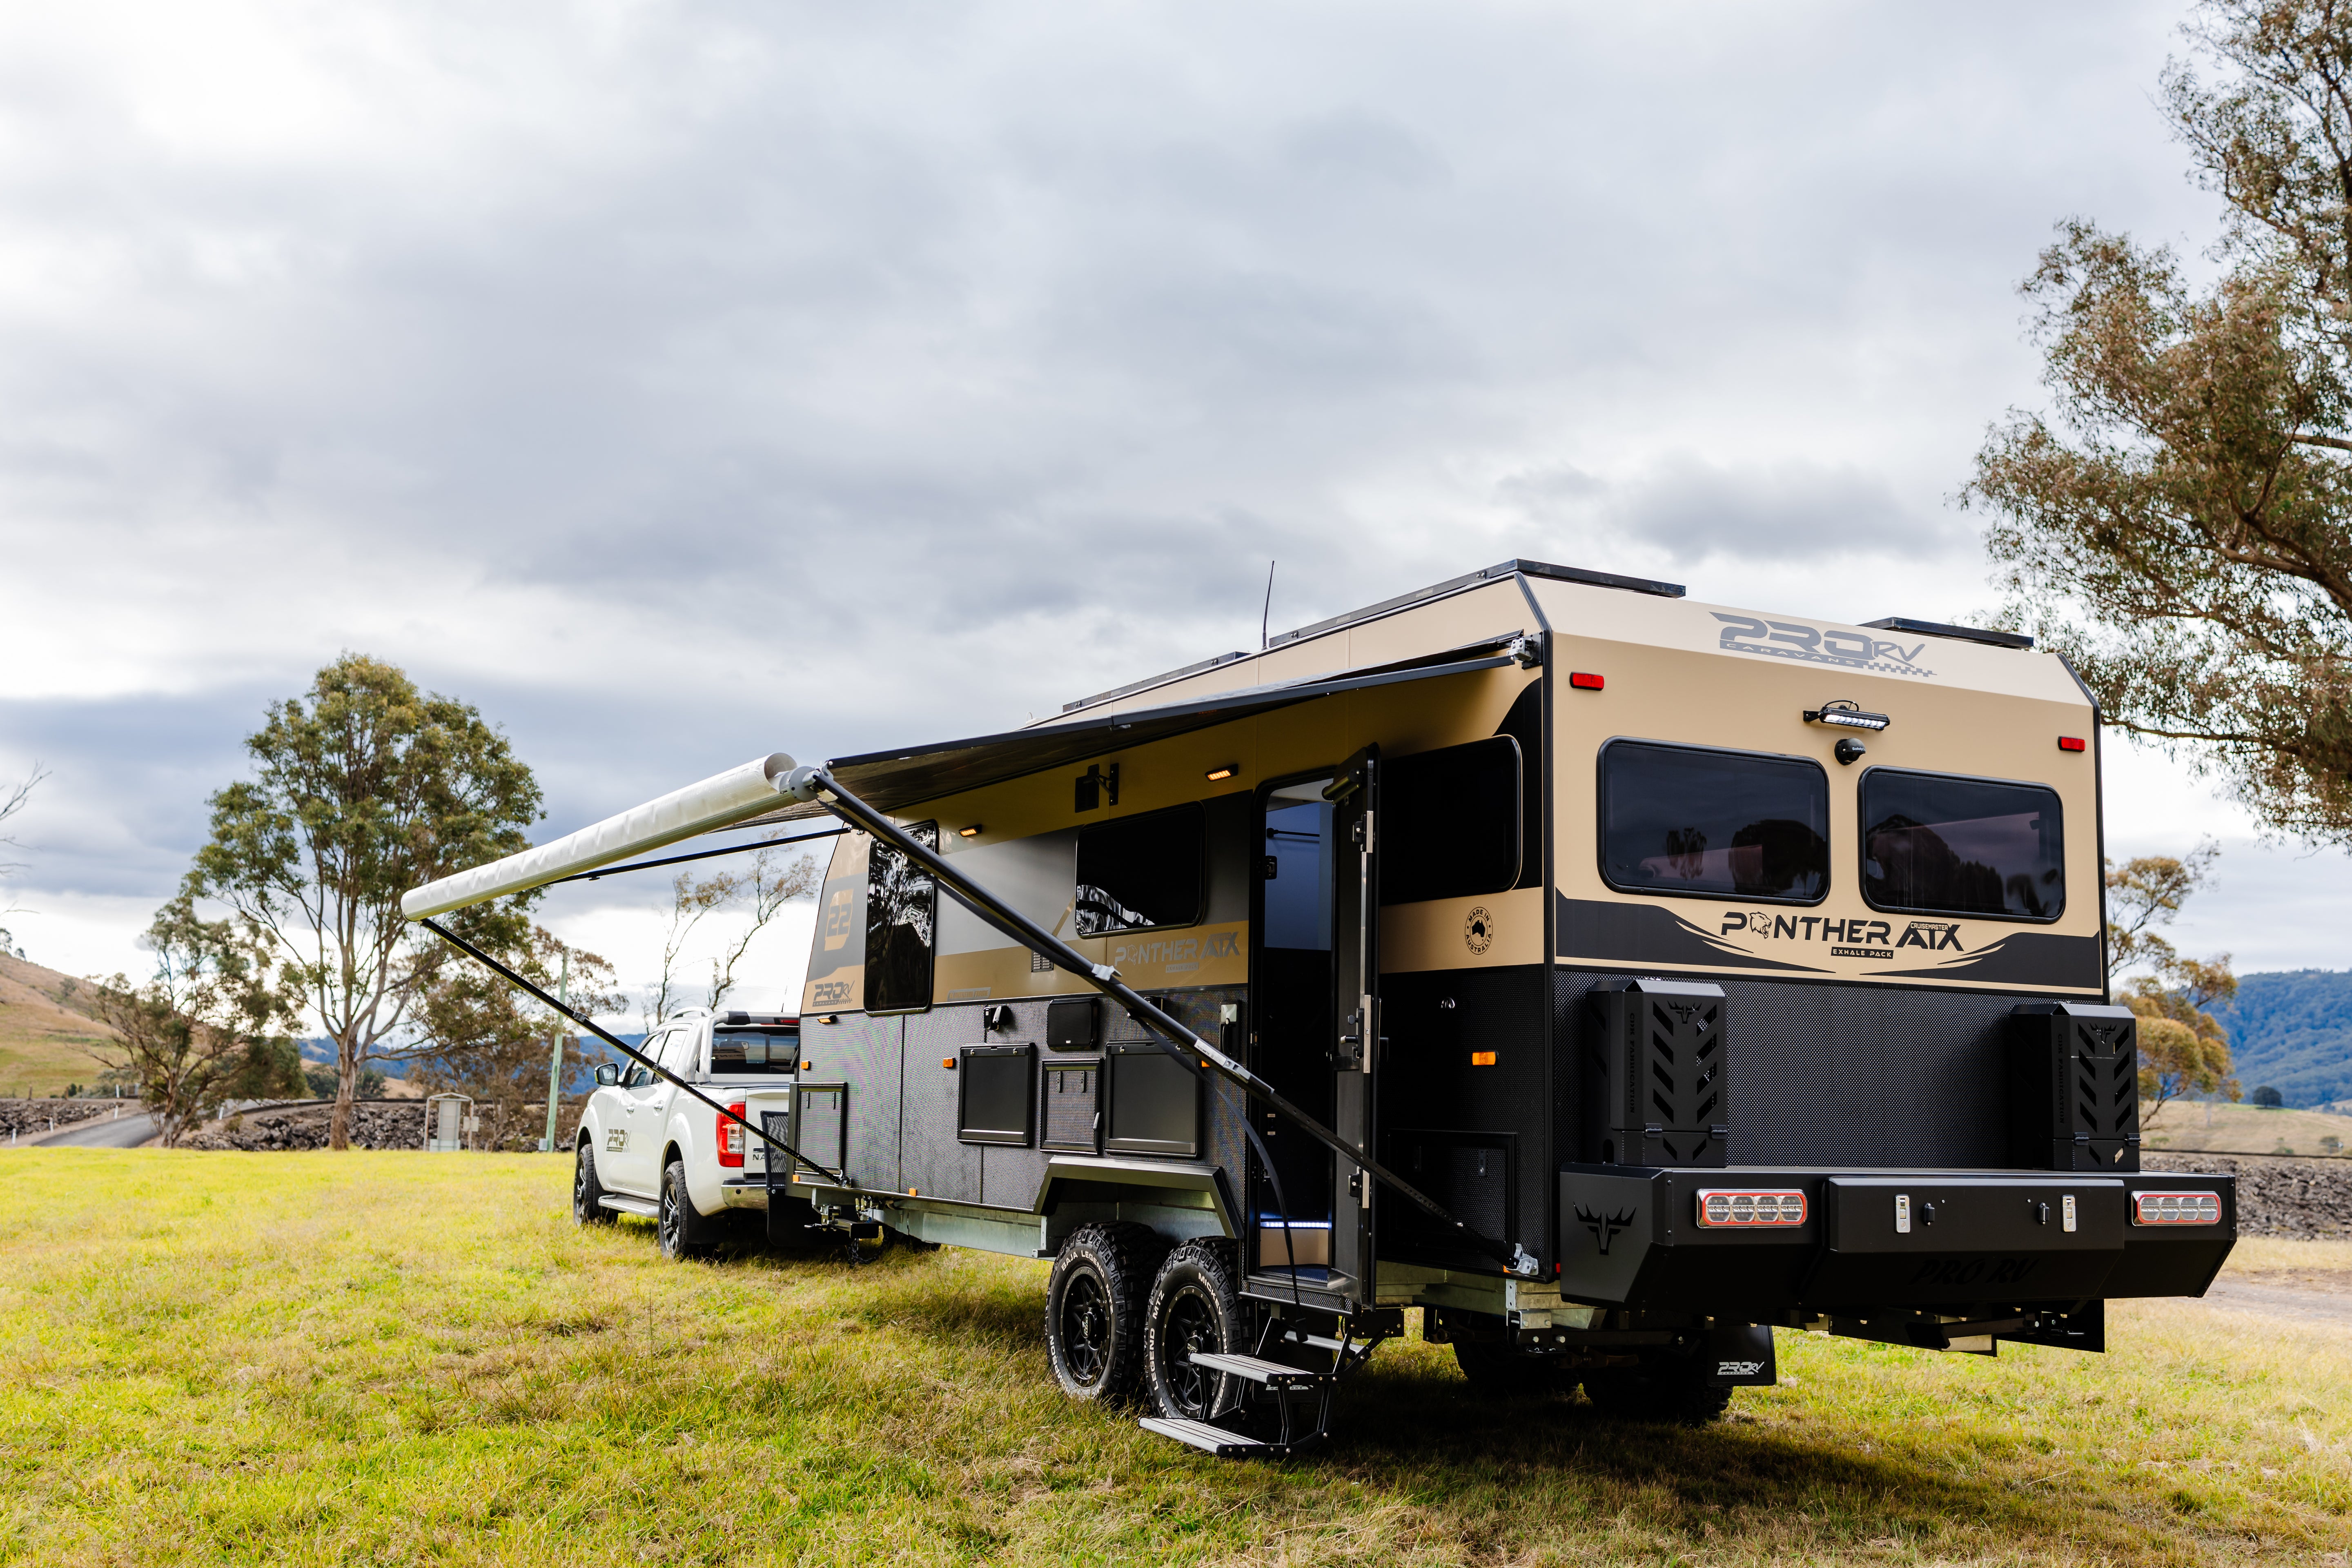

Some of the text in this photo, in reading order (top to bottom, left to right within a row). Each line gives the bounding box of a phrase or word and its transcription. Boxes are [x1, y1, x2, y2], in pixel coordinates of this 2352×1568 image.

[1726, 644, 1856, 665] CARAVANS
[826, 903, 852, 937] 22
[1468, 909, 1490, 922] MADE IN
[1910, 922, 1949, 931] CRUISEMASTER
[1466, 933, 1492, 953] AUSTRALIA
[1721, 911, 1964, 951] PNTHER ATX
[1114, 938, 1198, 967] PNTHER
[1061, 1251, 1078, 1271] BAJA
[1081, 1250, 1105, 1278] LEGEND
[1907, 1258, 2041, 1286] PRO RV
[1149, 1290, 1172, 1418] AJA LEGEND MTZ
[1198, 1272, 1227, 1417] MICKEY THPSON
